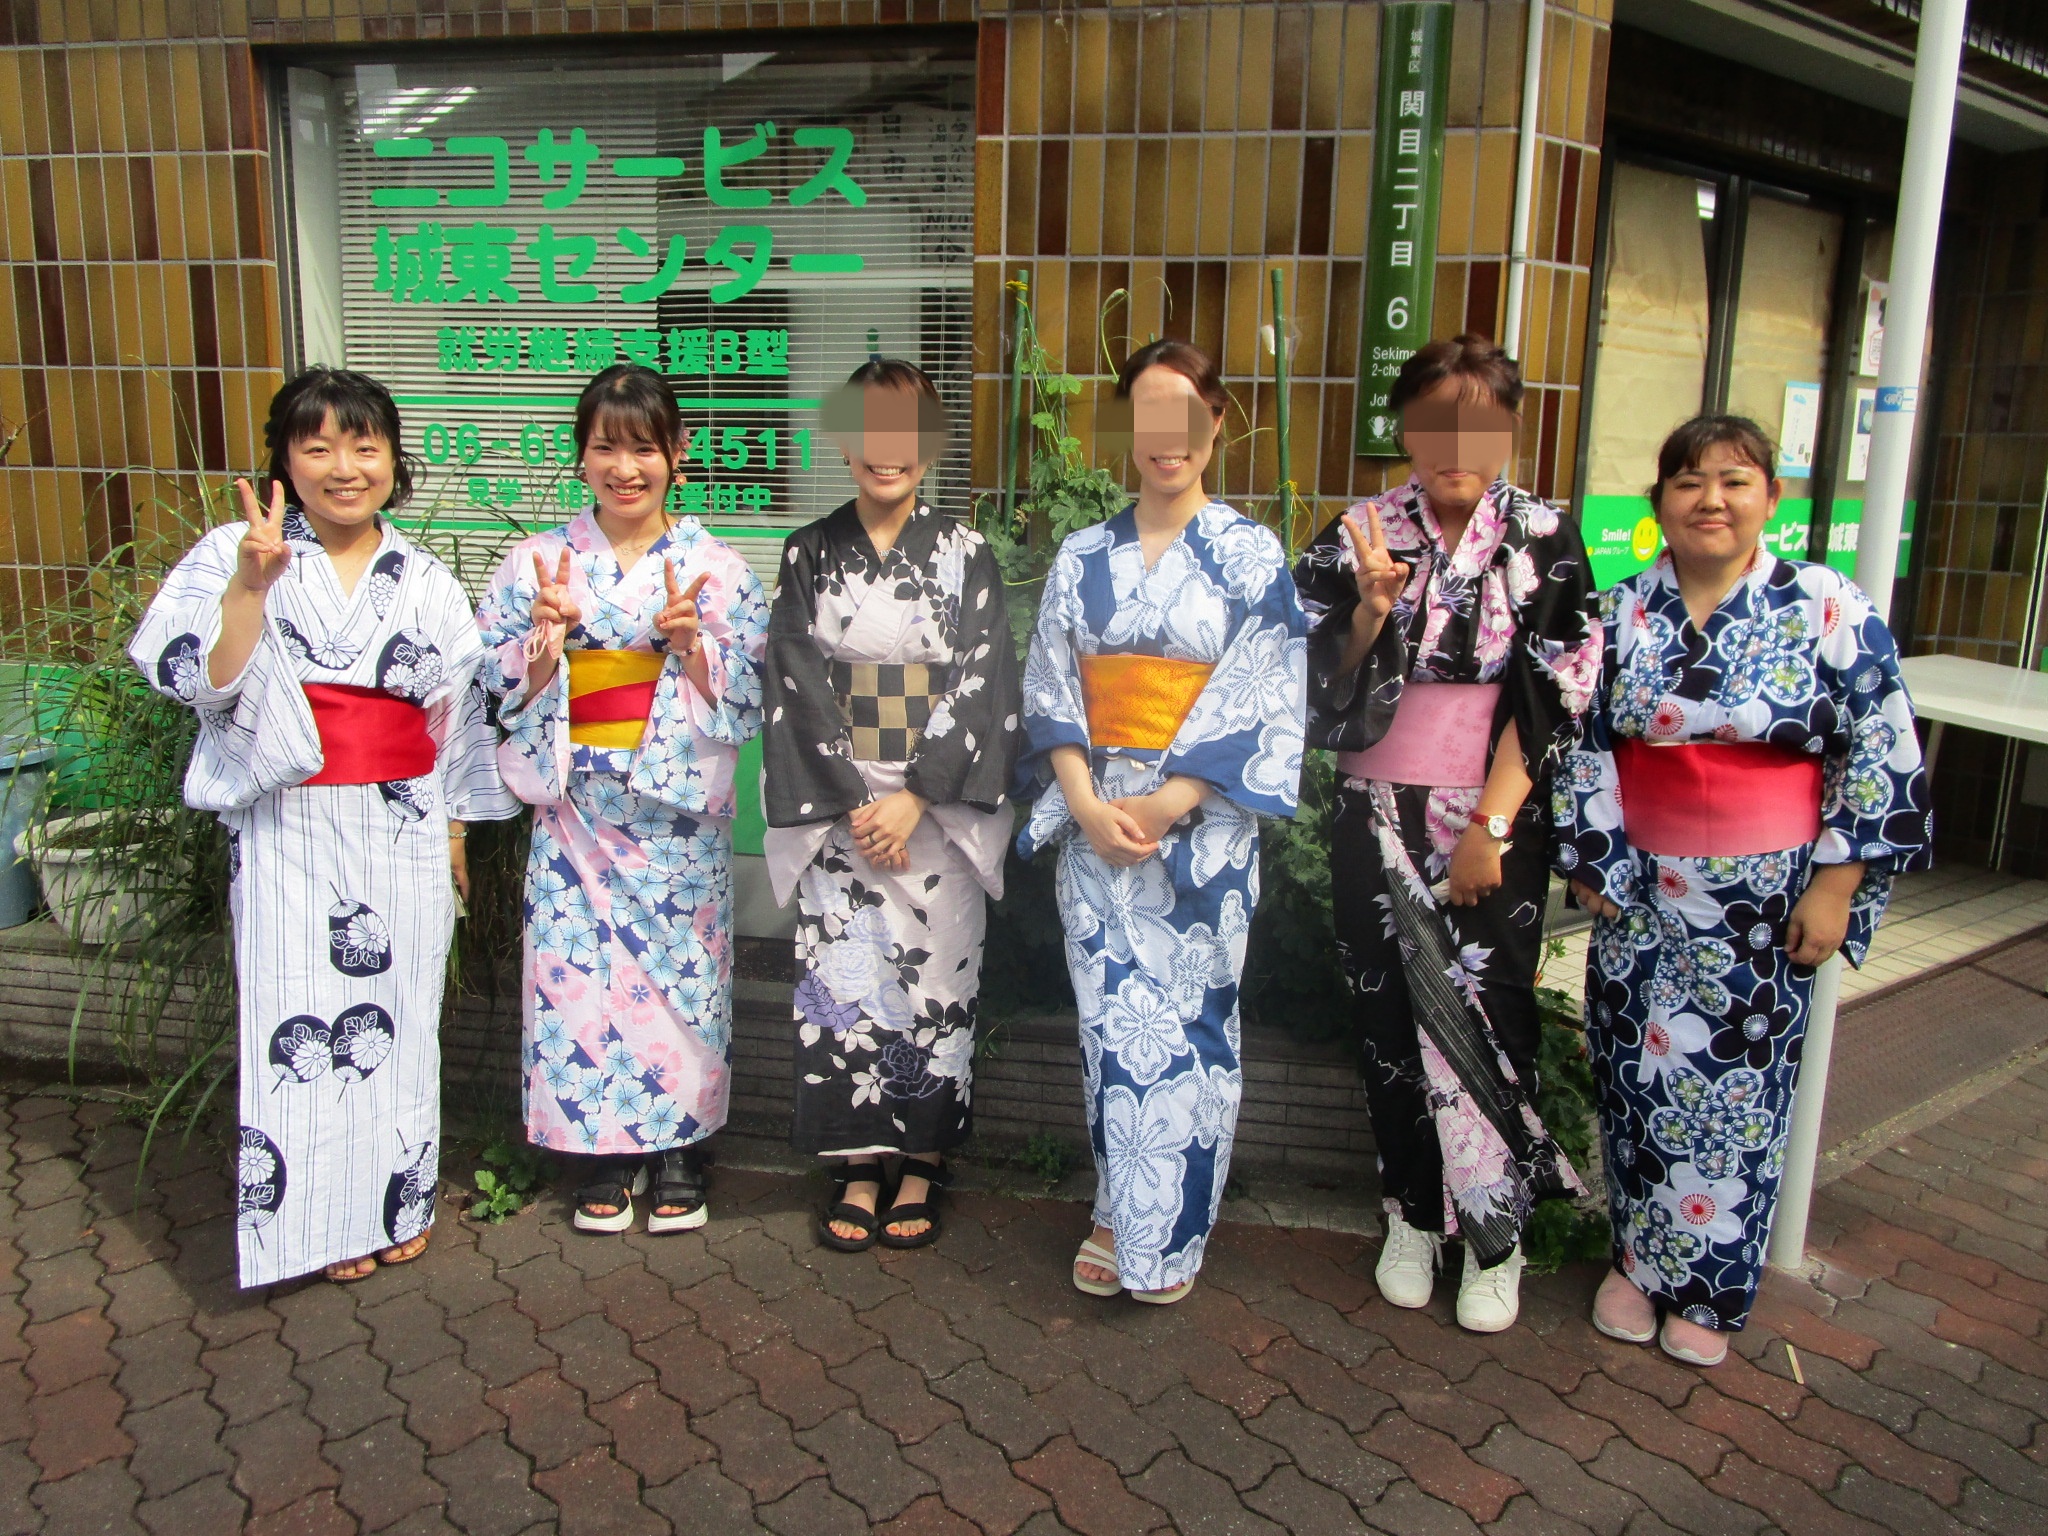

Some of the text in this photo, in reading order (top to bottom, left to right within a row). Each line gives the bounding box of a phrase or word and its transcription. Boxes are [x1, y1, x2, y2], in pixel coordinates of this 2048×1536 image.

[371, 120, 867, 209] ニコサービス
[1387, 29, 1425, 330] 城東区 関目二丁目 6
[371, 221, 864, 304] 城東センター
[436, 326, 789, 375] 就労継続支援B型
[1371, 363, 1401, 376] 2-cho
[1370, 393, 1388, 406] Jot
[424, 423, 811, 470] 06-694511
[1601, 528, 1631, 542] Smile!
